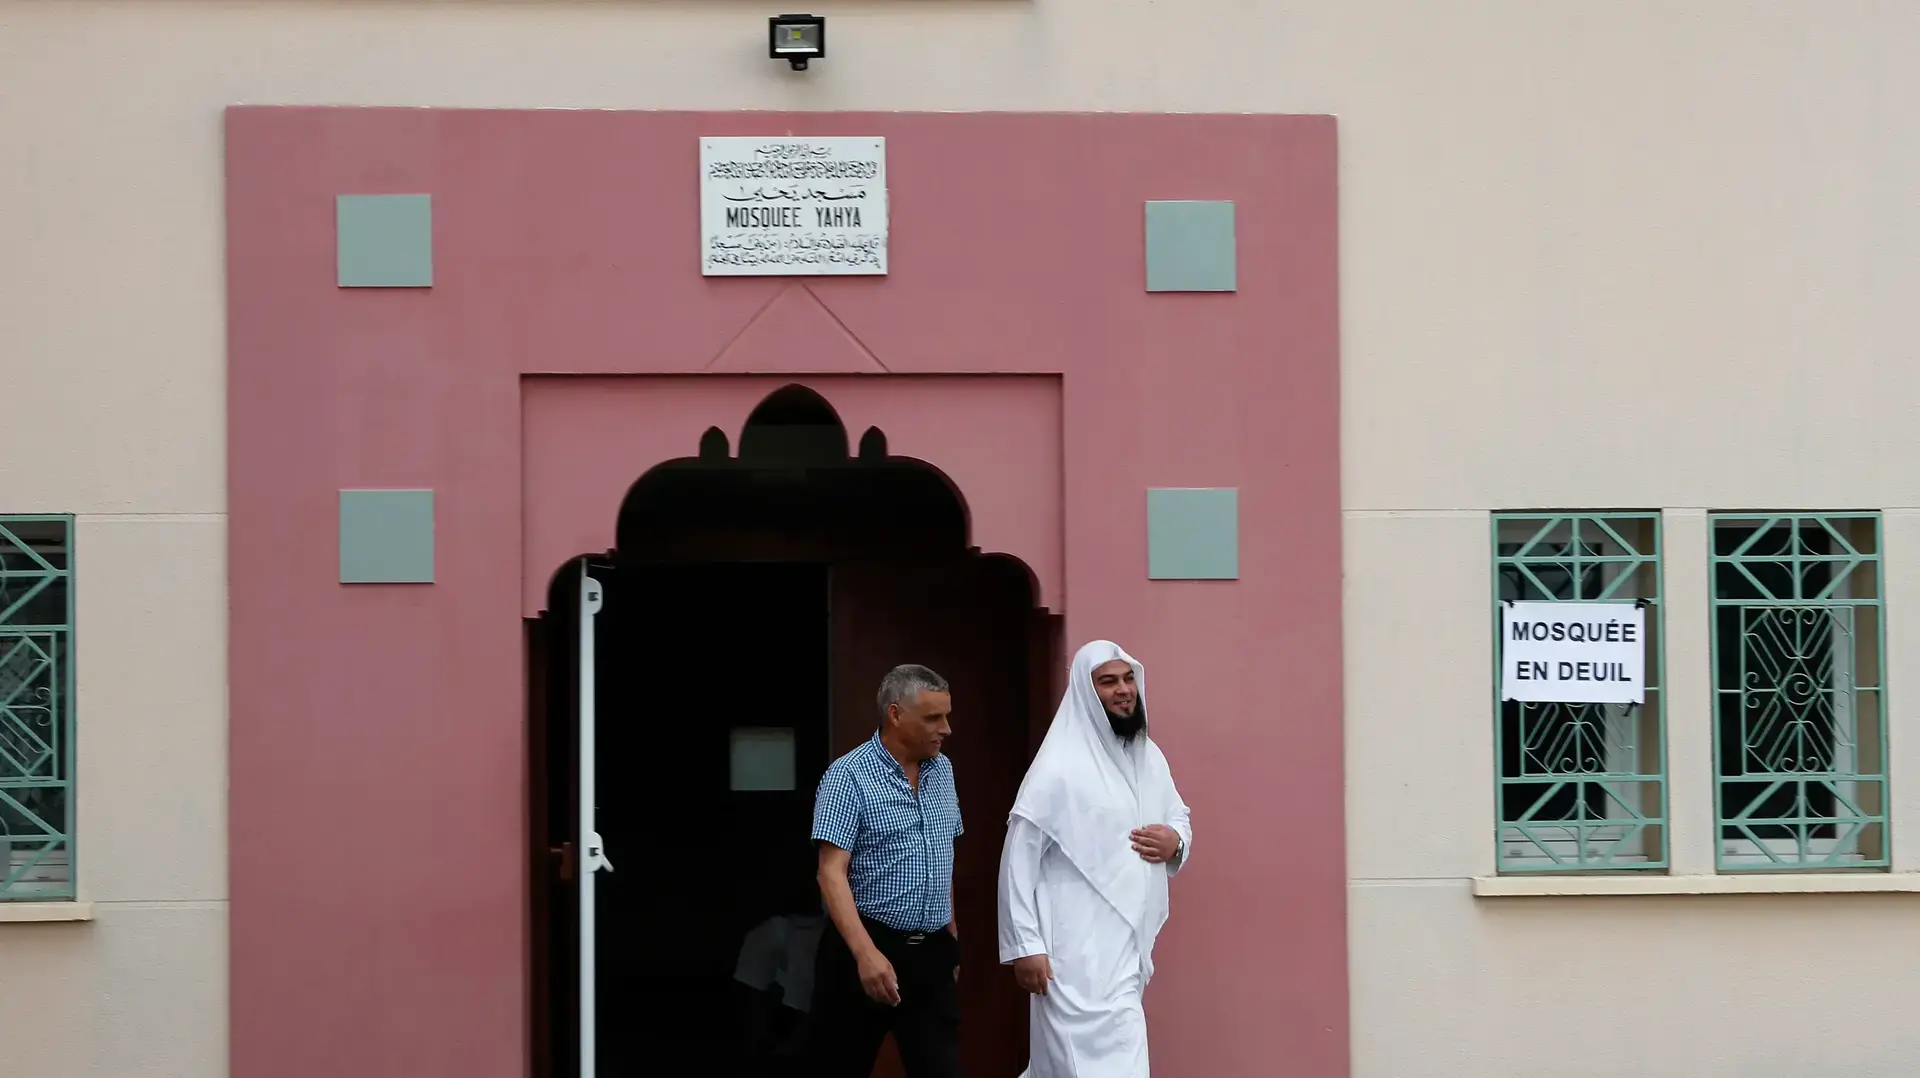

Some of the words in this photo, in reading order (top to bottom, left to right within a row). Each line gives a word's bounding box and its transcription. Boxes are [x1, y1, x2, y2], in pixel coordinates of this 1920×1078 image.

[726, 206, 802, 228] MOSQUEE
[815, 206, 861, 228] YAHYA
[1512, 619, 1637, 643] MOSQUÉE
[1516, 661, 1548, 681] EN
[1558, 662, 1632, 682] DEUIL
